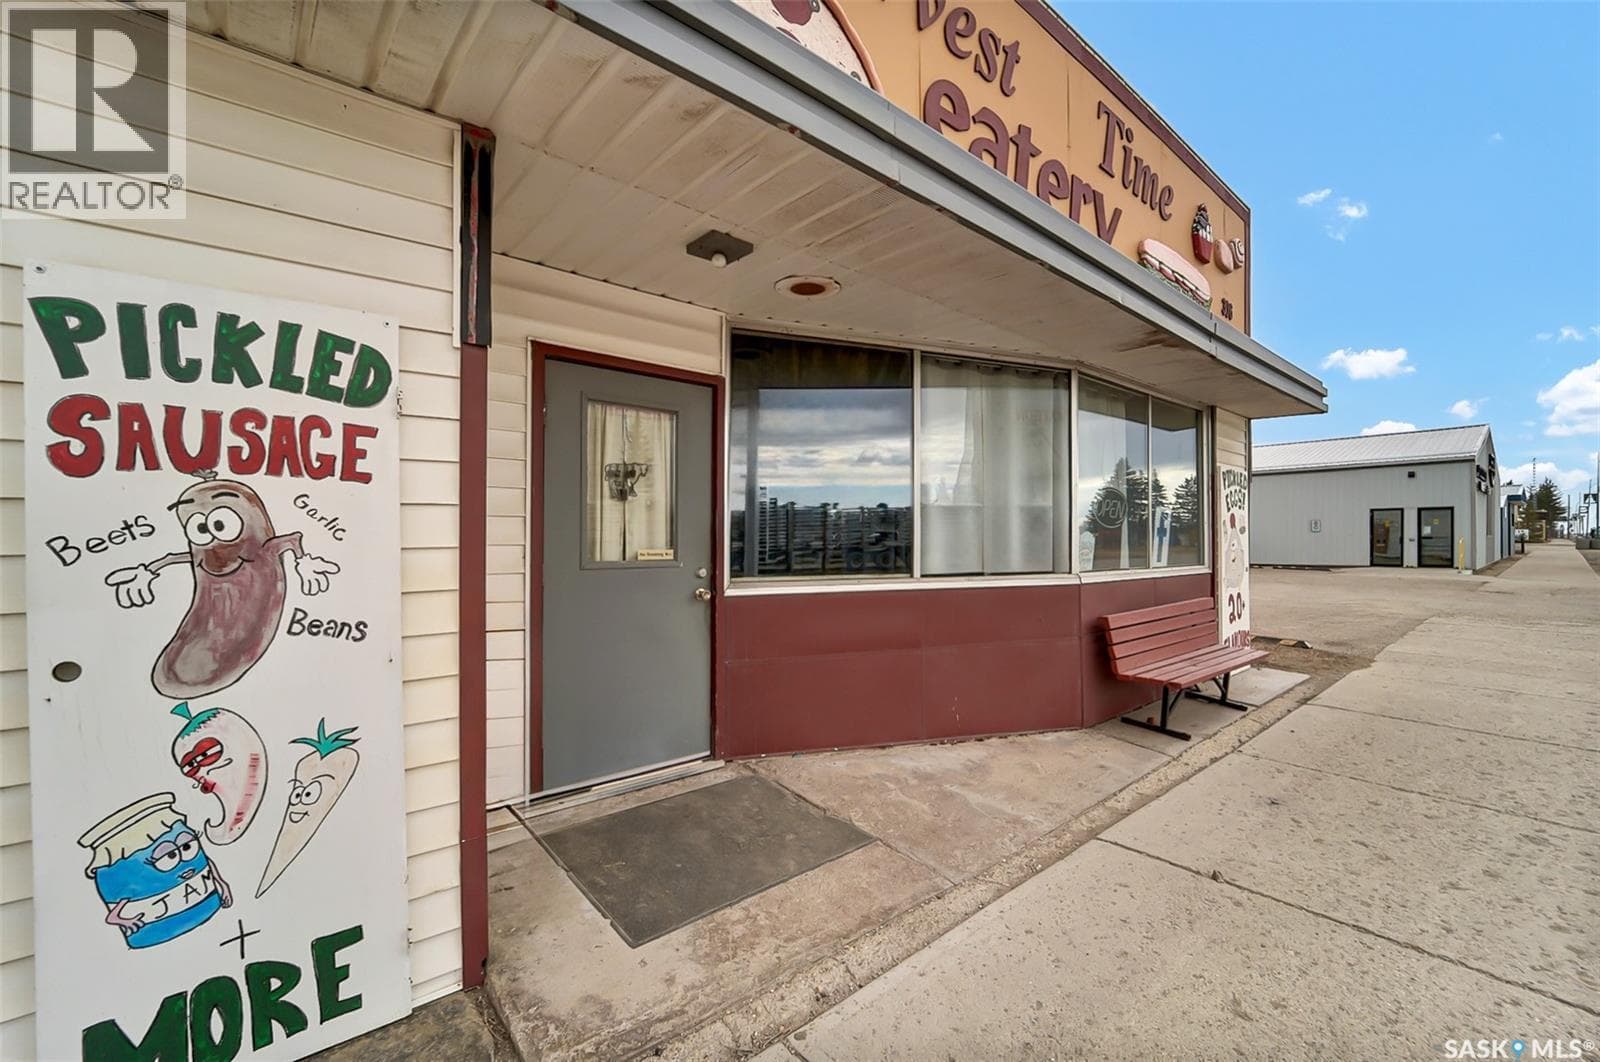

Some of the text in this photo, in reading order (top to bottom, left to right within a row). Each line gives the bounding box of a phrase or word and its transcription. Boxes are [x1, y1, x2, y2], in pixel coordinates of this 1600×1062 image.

[1097, 100, 1175, 222] Time
[28, 296, 393, 408] PICKLED
[46, 393, 379, 484] SAUSAGE
[293, 494, 347, 542] Garlic
[1094, 499, 1127, 519] OPEN
[45, 514, 156, 567] Beets
[286, 608, 369, 642] Beans
[151, 869, 217, 920] JAM
[82, 925, 365, 1062] MORE
